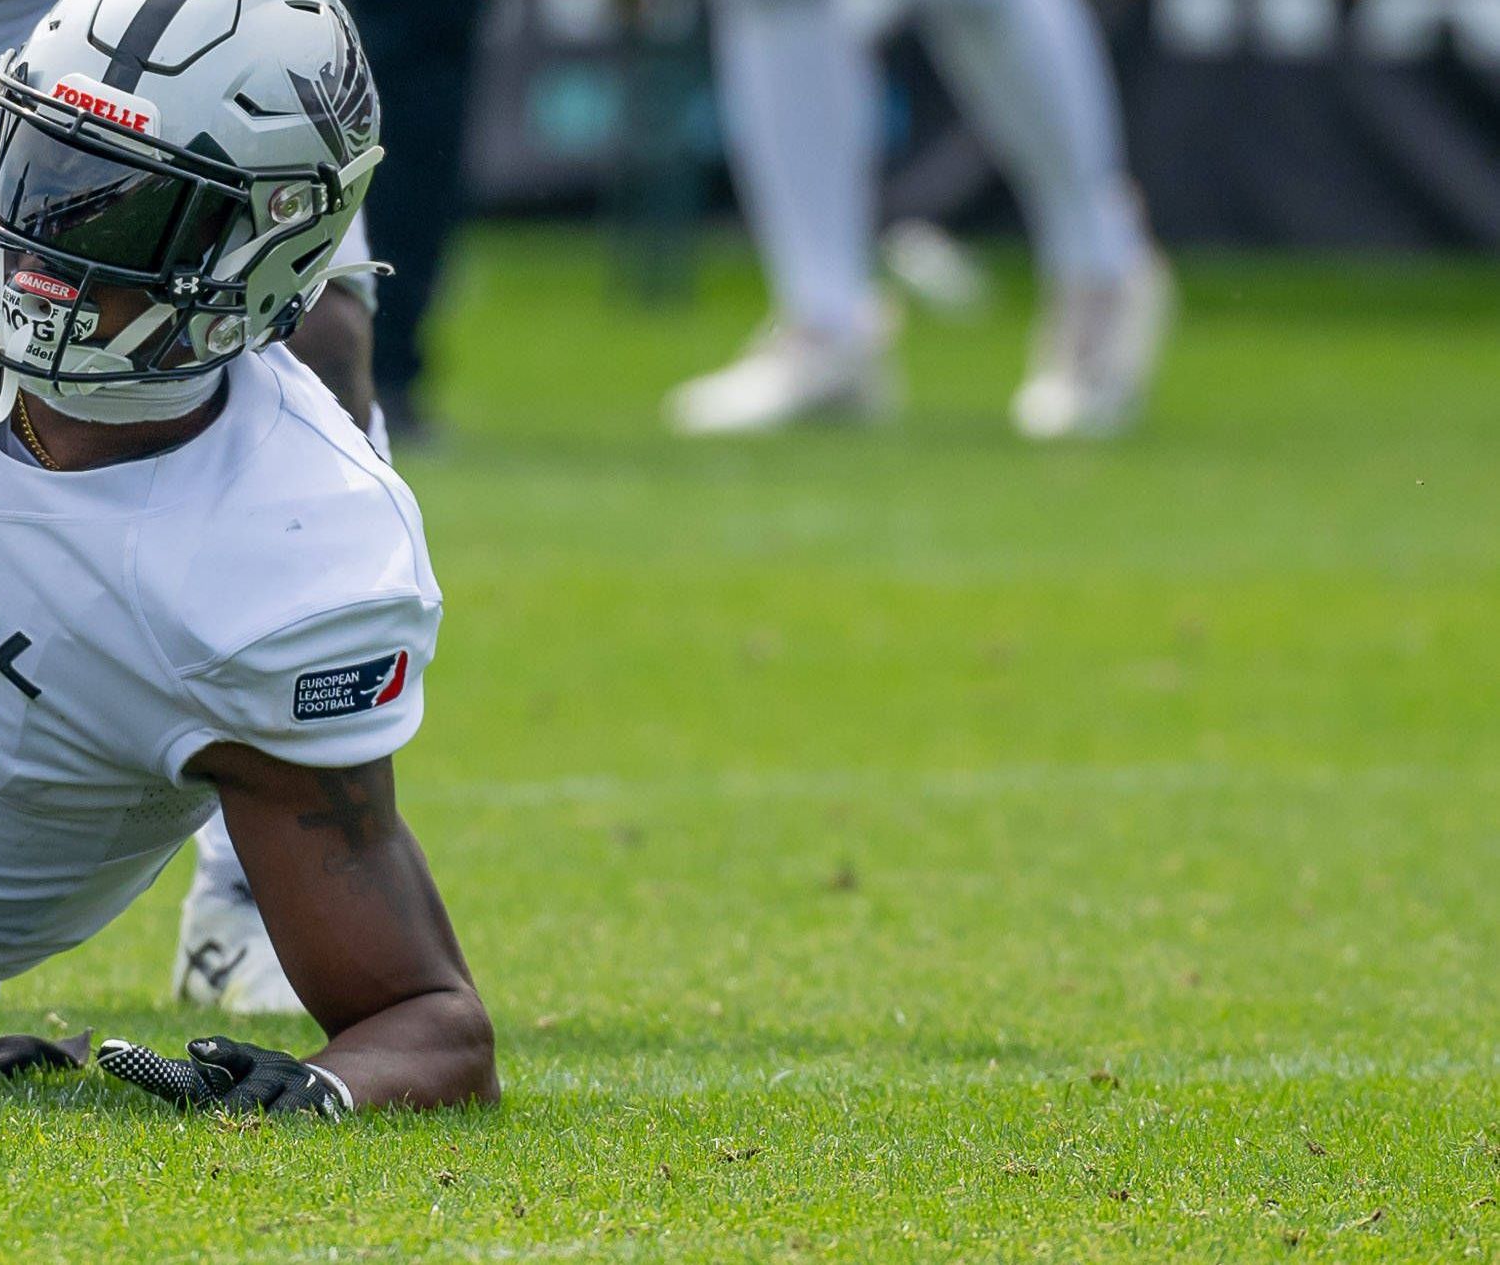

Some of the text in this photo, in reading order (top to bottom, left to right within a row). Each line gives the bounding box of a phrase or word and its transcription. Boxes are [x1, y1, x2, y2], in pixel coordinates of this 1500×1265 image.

[52, 83, 151, 135] FORELLE
[19, 274, 70, 298] DANGER
[300, 672, 359, 690] EUROPEAN
[299, 687, 342, 702] LEAGUE
[297, 695, 355, 713] FOOTBALL
